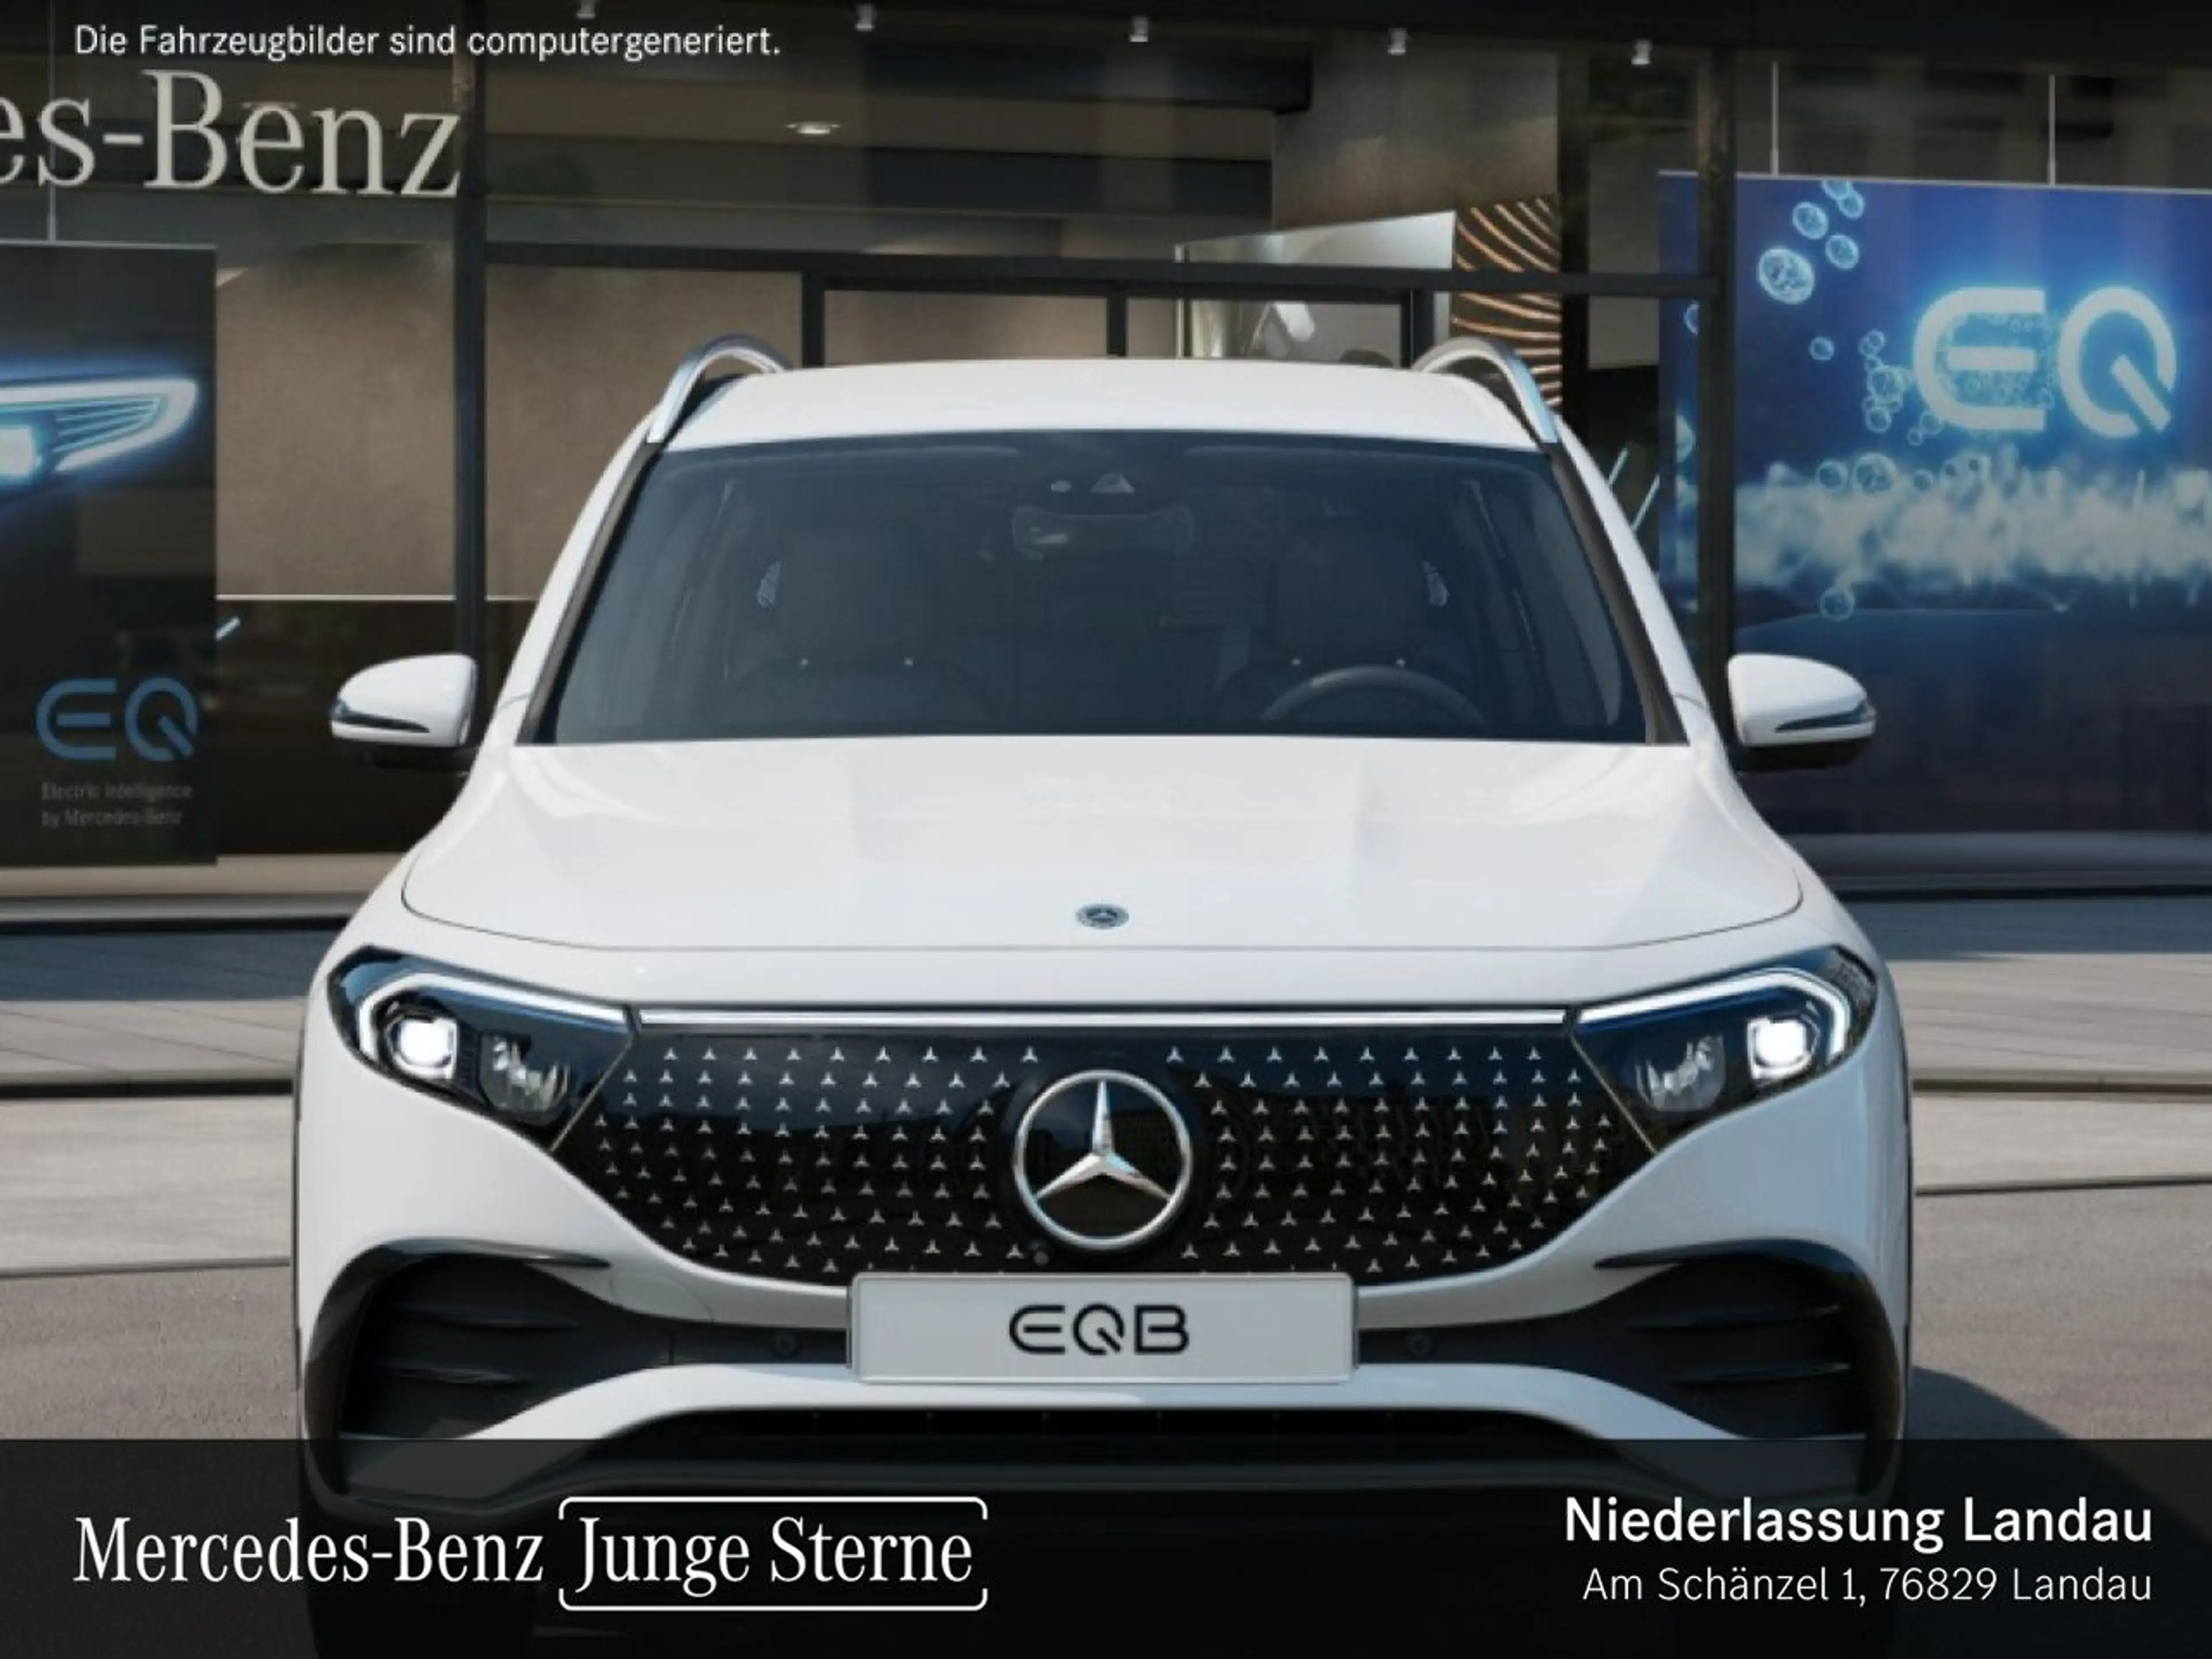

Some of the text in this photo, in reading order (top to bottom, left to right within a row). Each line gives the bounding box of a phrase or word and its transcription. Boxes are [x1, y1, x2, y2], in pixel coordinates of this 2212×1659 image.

[1913, 286, 2176, 438] EQ
[36, 677, 198, 761] EQ
[1009, 1304, 1190, 1356] EQB
